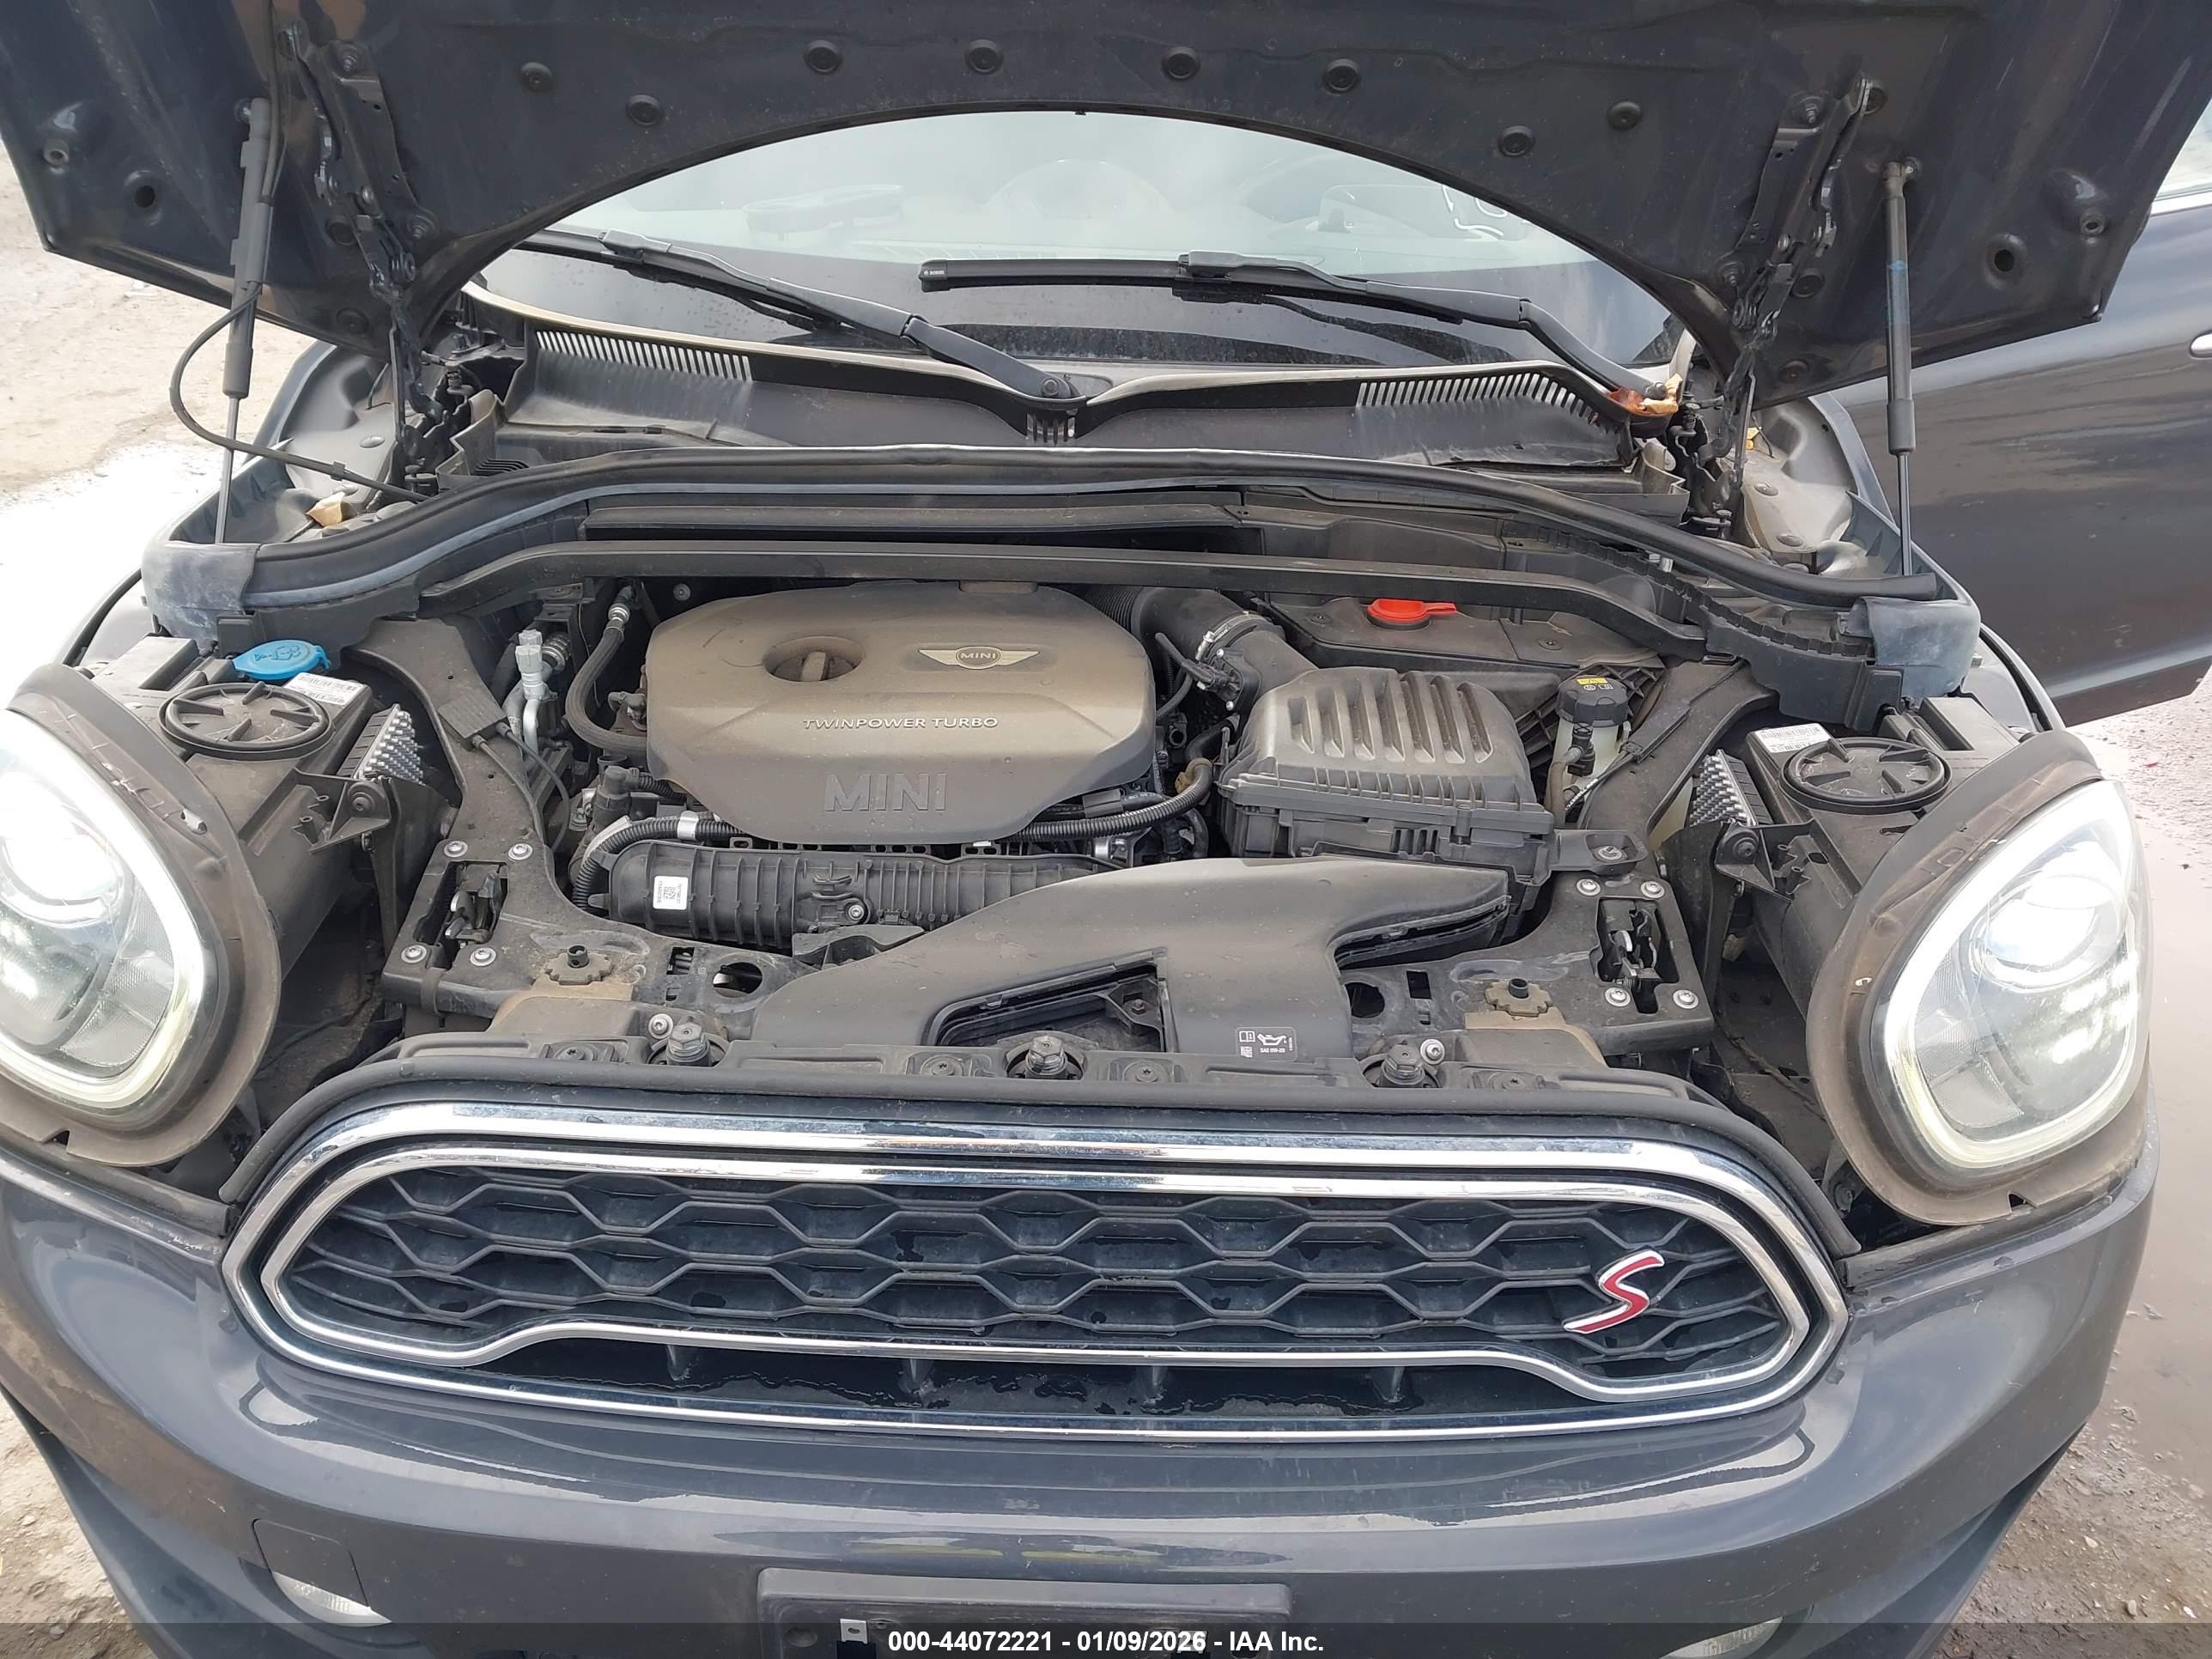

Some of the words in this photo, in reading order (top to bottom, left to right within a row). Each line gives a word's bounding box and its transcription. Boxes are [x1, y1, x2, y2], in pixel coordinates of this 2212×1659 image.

[804, 718, 926, 729] TWINPOWER
[932, 717, 998, 728] TURBO
[824, 773, 947, 811] MINI
[1563, 1249, 1665, 1334] S
